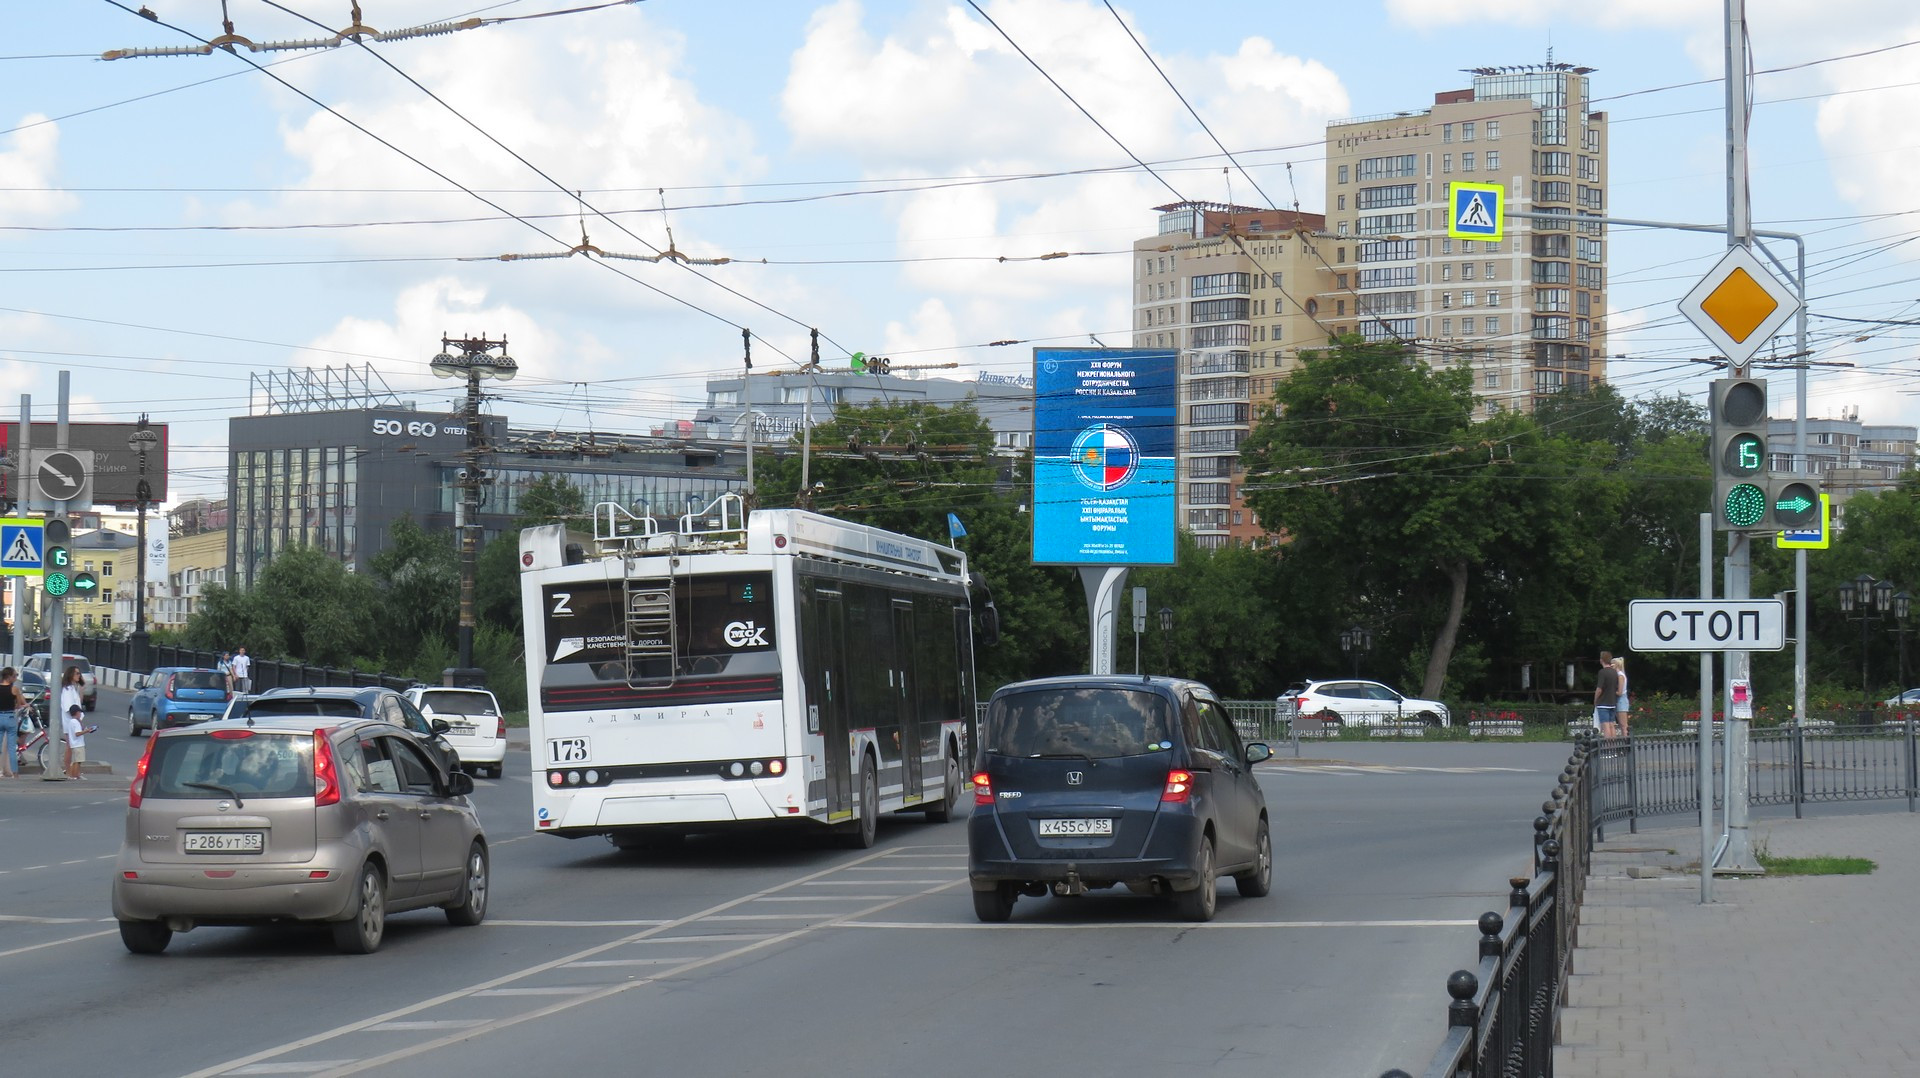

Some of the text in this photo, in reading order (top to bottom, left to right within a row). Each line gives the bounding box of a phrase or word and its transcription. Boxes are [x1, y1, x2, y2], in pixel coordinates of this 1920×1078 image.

[1101, 361, 1122, 369] ФОРУМ
[1076, 370, 1136, 378] МЕЖРЕГИОНАЛЬНОГО
[1081, 379, 1130, 388] СОТРУДНИЧЕСТВА
[1075, 388, 1097, 396] РОССИИ
[1102, 388, 1137, 396] КАЗАХСТАНА
[373, 419, 402, 436] 50
[407, 421, 437, 438] 60
[1739, 442, 1758, 468] 15
[56, 550, 68, 566] 15
[552, 593, 573, 613] Z
[1654, 610, 1760, 641] СТОП
[638, 639, 663, 647] ДОРОГИ
[587, 707, 734, 724] АДМИРАЛ
[551, 738, 588, 762] 173
[999, 791, 1022, 799] FREED
